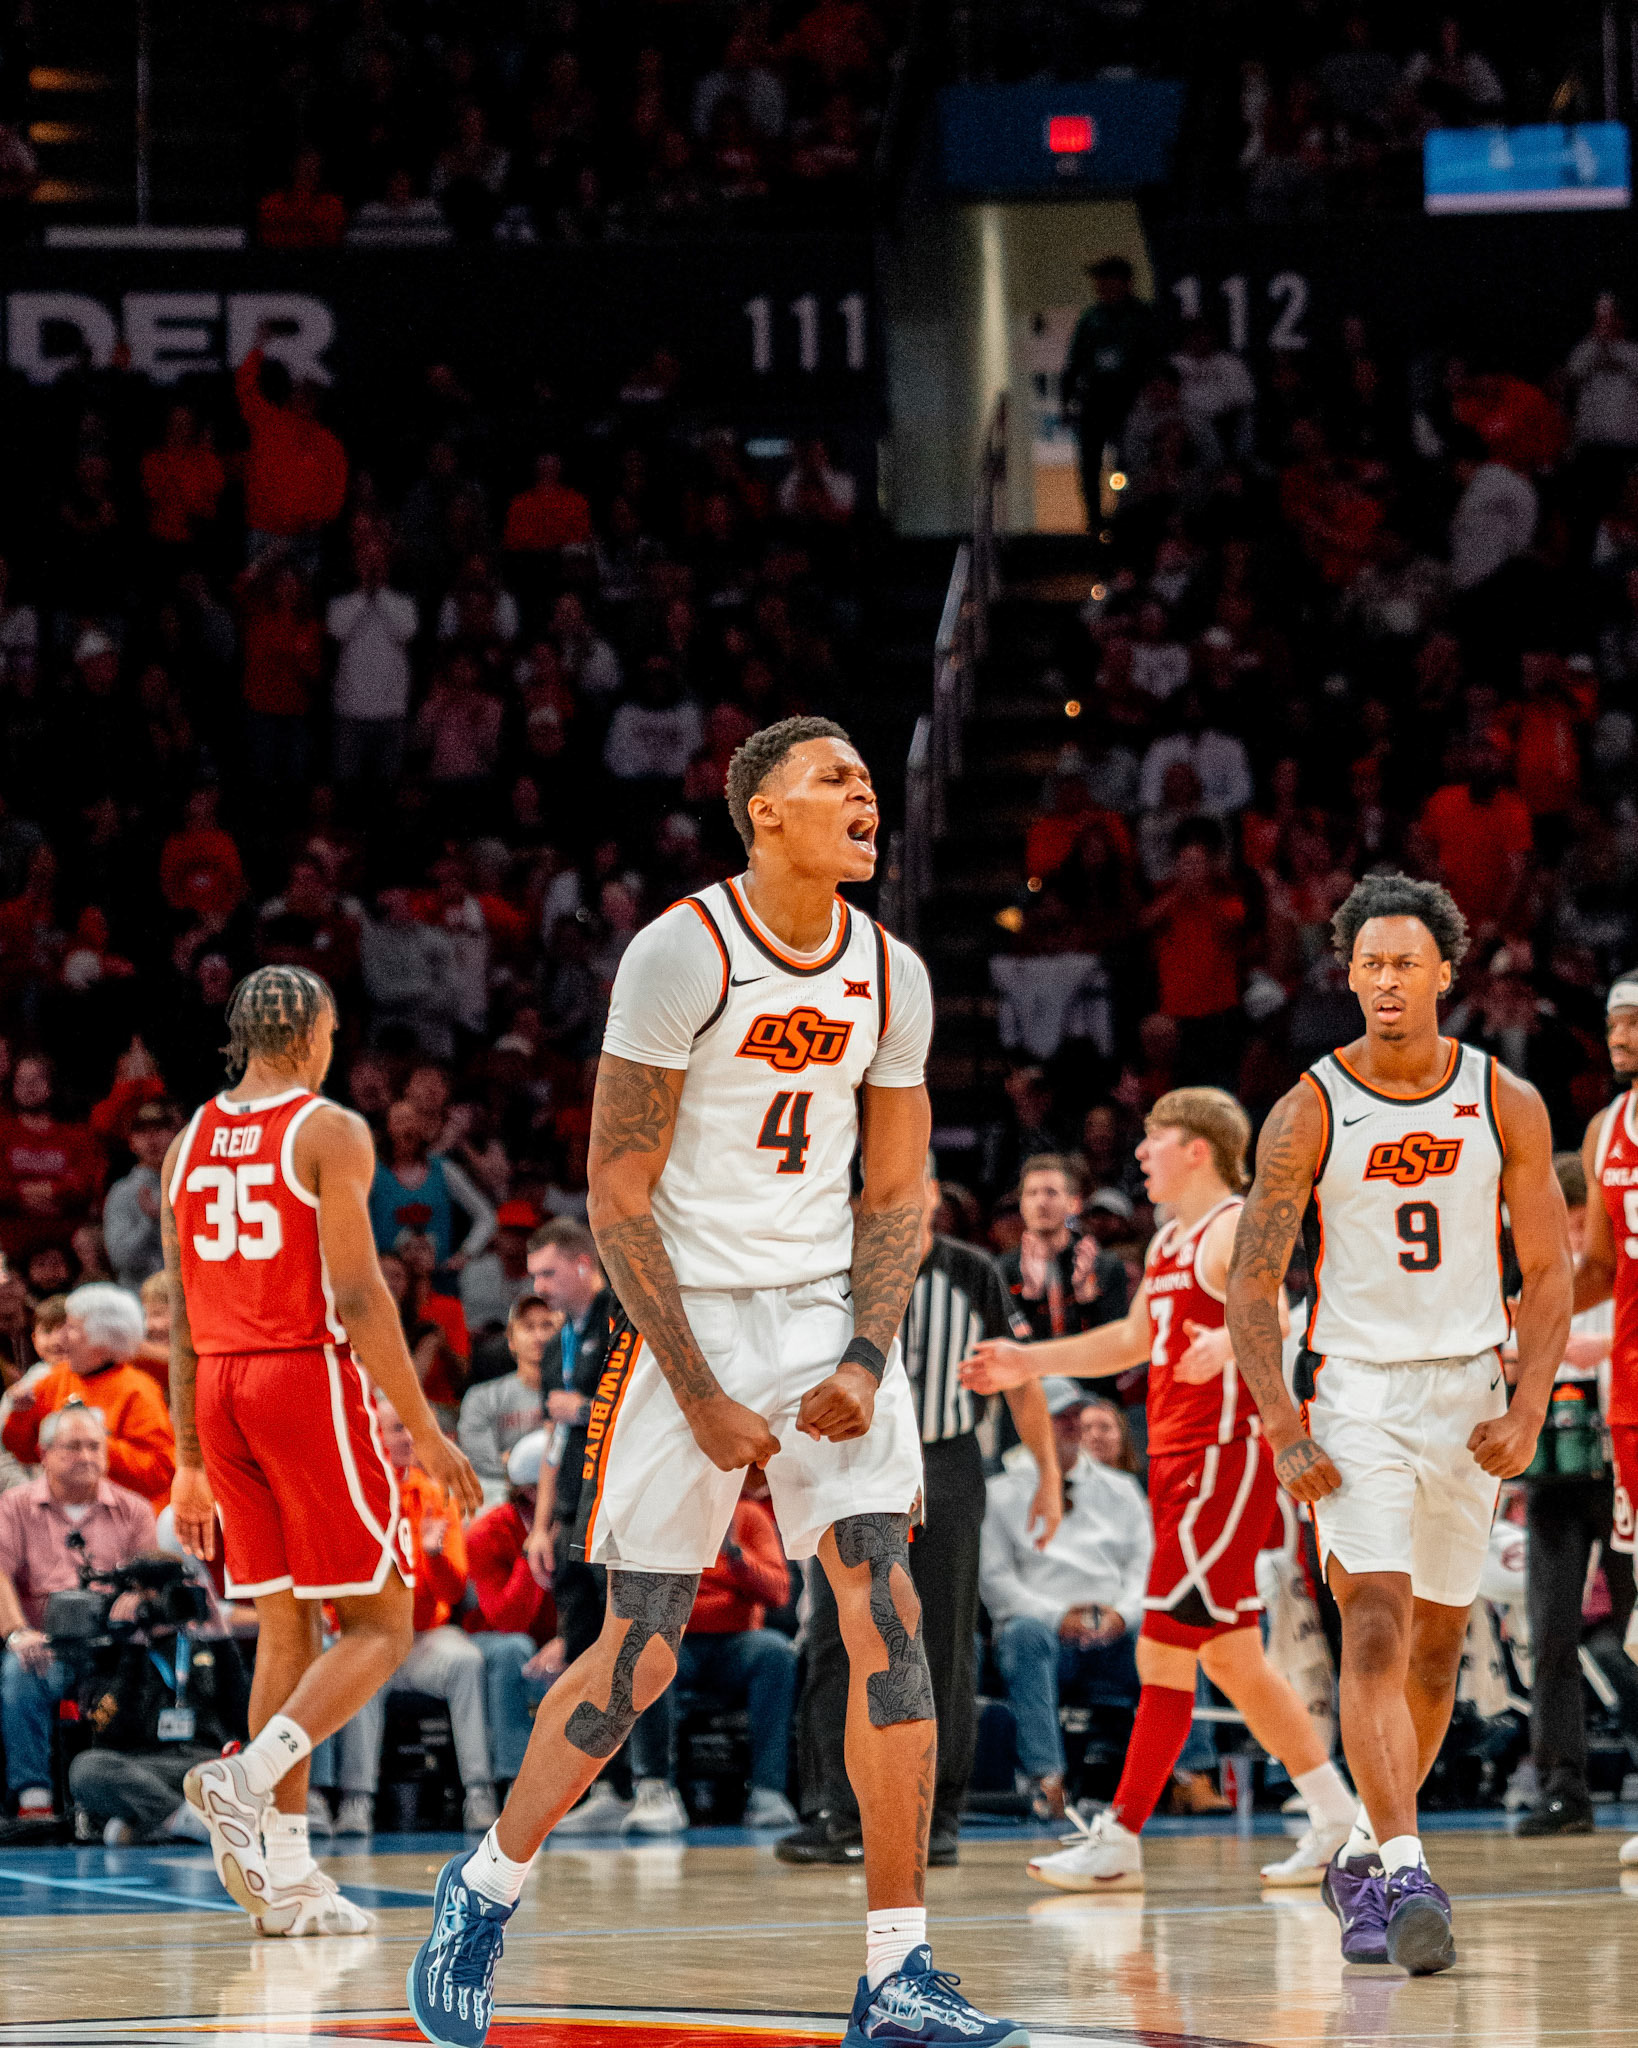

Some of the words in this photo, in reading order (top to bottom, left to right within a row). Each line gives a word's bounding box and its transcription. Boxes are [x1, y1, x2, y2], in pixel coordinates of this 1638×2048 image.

[7, 290, 335, 386] DER
[743, 294, 866, 371] 111
[1170, 272, 1307, 349] 112
[735, 1006, 855, 1074] OSU
[210, 1124, 263, 1157] REID
[756, 1091, 814, 1174] 4
[1362, 1131, 1464, 1188] OSU
[186, 1163, 282, 1261] 35
[1394, 1200, 1442, 1273] 9
[1150, 1296, 1173, 1367] 7
[582, 1331, 632, 1480] COWBOYS
[278, 1729, 299, 1754] 23
